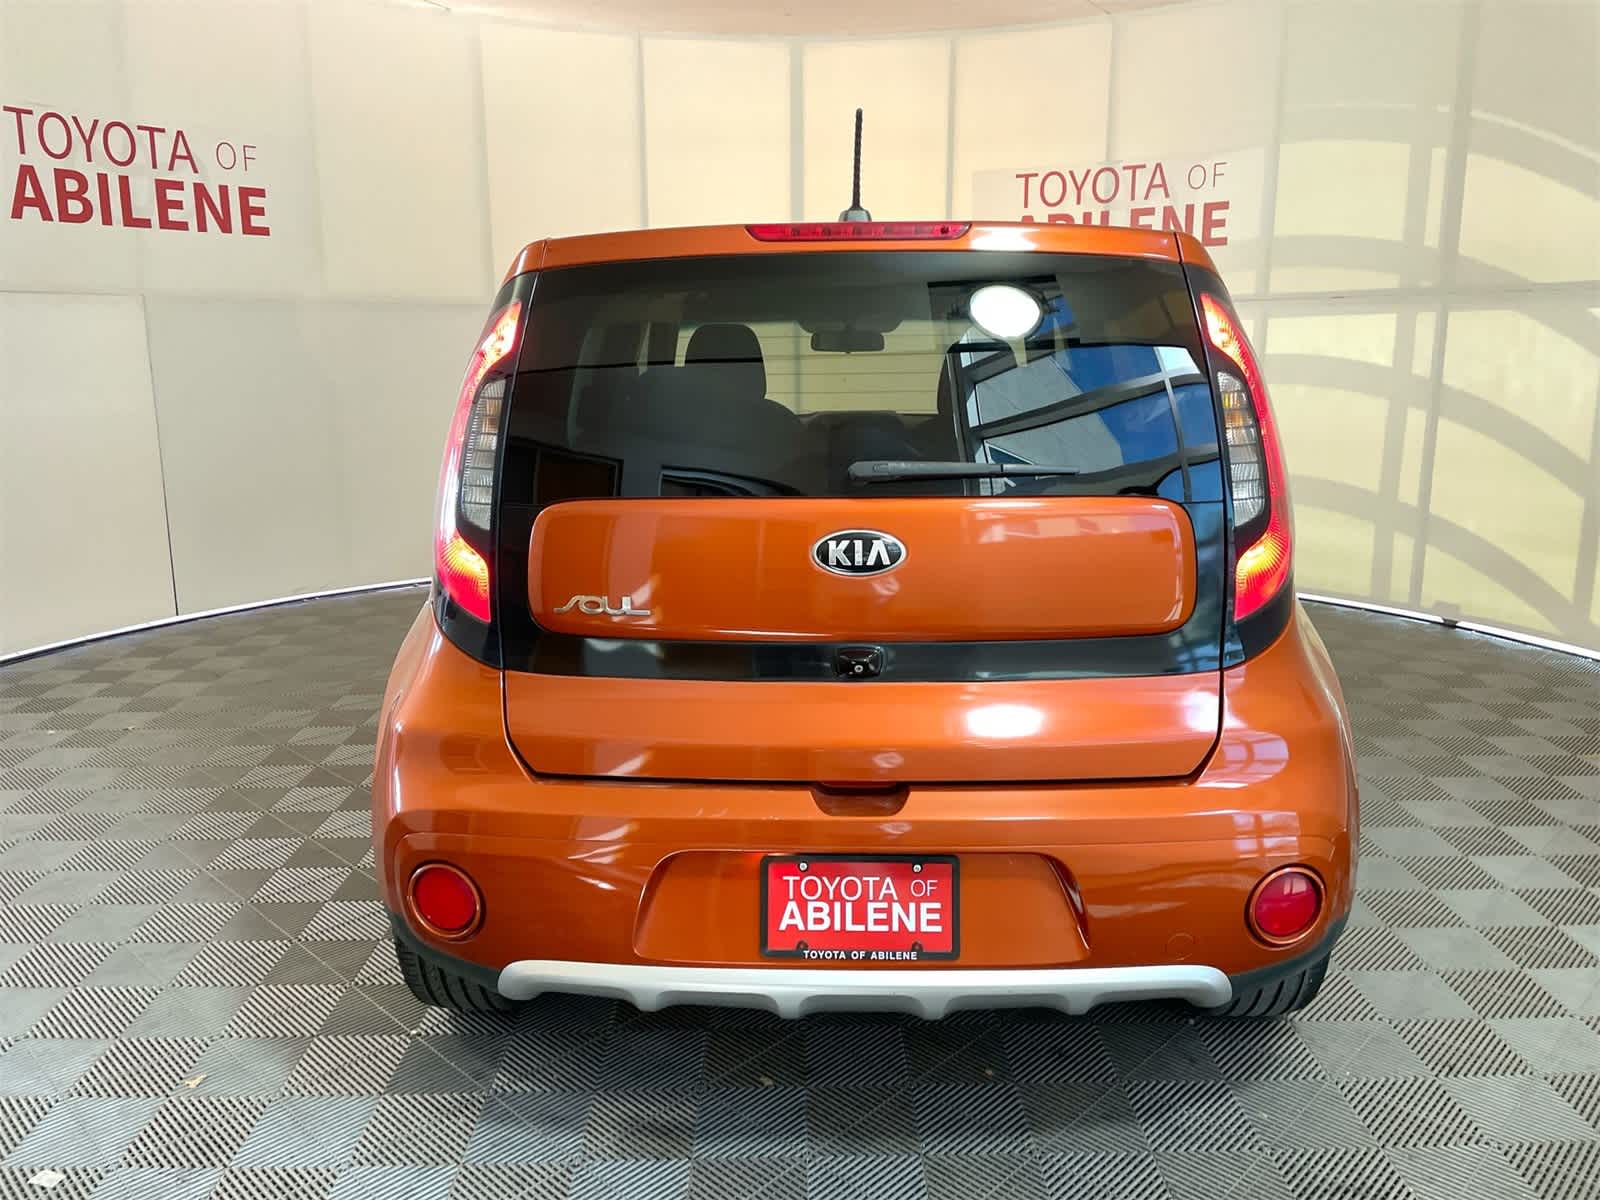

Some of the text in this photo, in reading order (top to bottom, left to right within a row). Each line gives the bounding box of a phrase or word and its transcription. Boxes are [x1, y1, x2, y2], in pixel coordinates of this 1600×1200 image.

[3, 105, 257, 174] TOYOTA OF
[1015, 162, 1227, 208] TOYOTA OF
[11, 164, 271, 236] ABILENE
[827, 539, 892, 566] KIA
[553, 595, 651, 616] SOUL
[782, 875, 938, 901] TOYOTA OF
[779, 900, 943, 932] ABILENE
[803, 950, 918, 960] TOYOTA OF ABILENE
